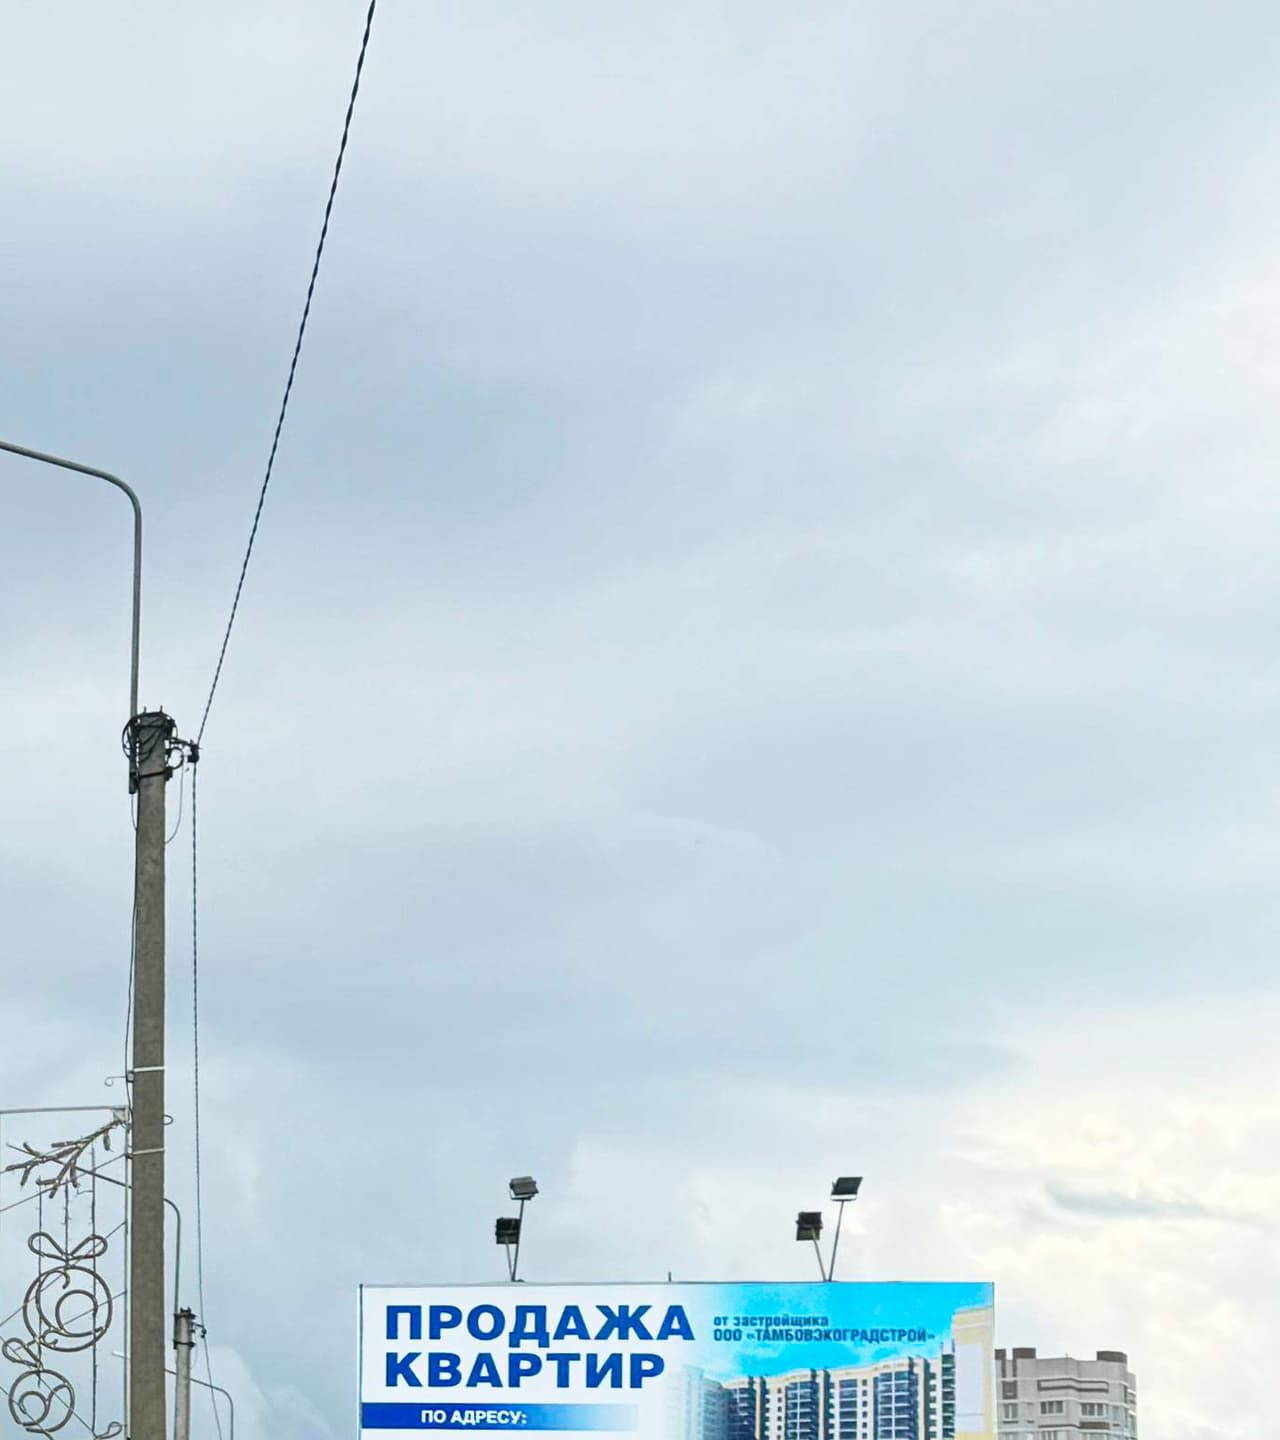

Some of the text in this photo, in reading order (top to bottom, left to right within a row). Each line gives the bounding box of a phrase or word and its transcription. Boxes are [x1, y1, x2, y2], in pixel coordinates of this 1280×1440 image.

[386, 1304, 695, 1348] ПРОДАЖА
[713, 1315, 829, 1328] от застройщика
[713, 1327, 935, 1343] ООО «ТАМБОВЭКОГРАДСТРОЙ»
[385, 1352, 665, 1388] КВАРТИР
[421, 1410, 527, 1425] ПО АДРЕСУ:
